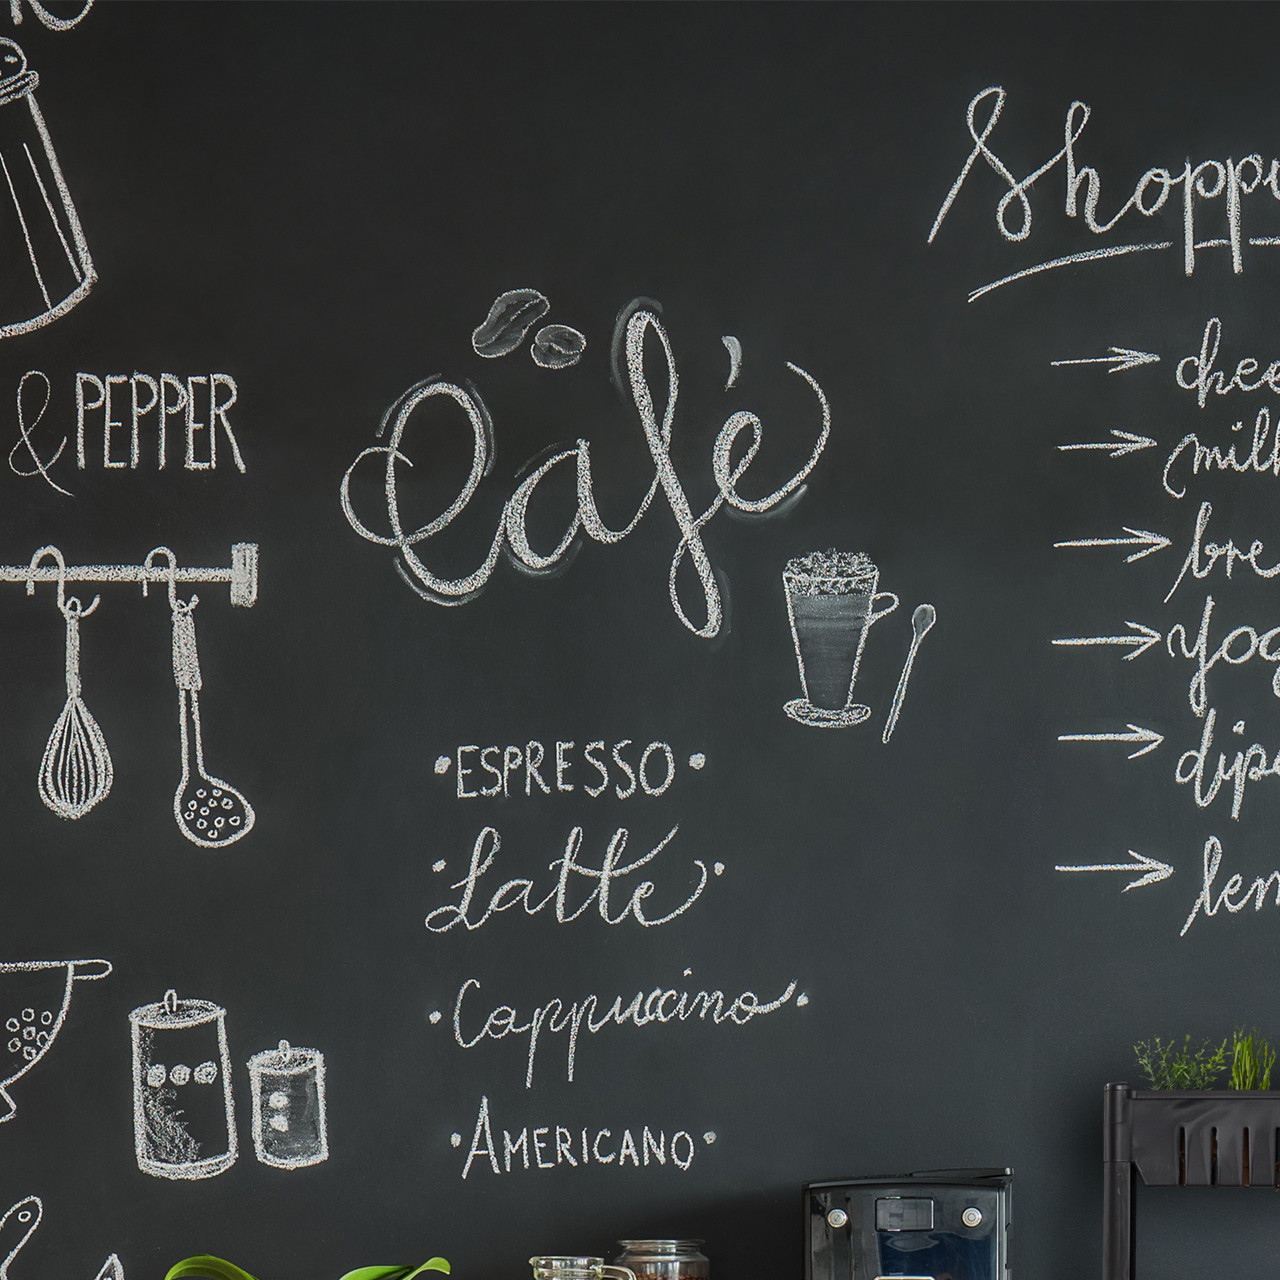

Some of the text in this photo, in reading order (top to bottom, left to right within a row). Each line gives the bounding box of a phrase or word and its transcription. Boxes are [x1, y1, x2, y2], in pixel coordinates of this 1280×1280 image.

[8, 370, 246, 497] & PEPPER
[339, 308, 831, 638] Café
[456, 739, 676, 800] ESPRESSO
[424, 824, 708, 933] Latte
[452, 967, 798, 1089] Cappuccino
